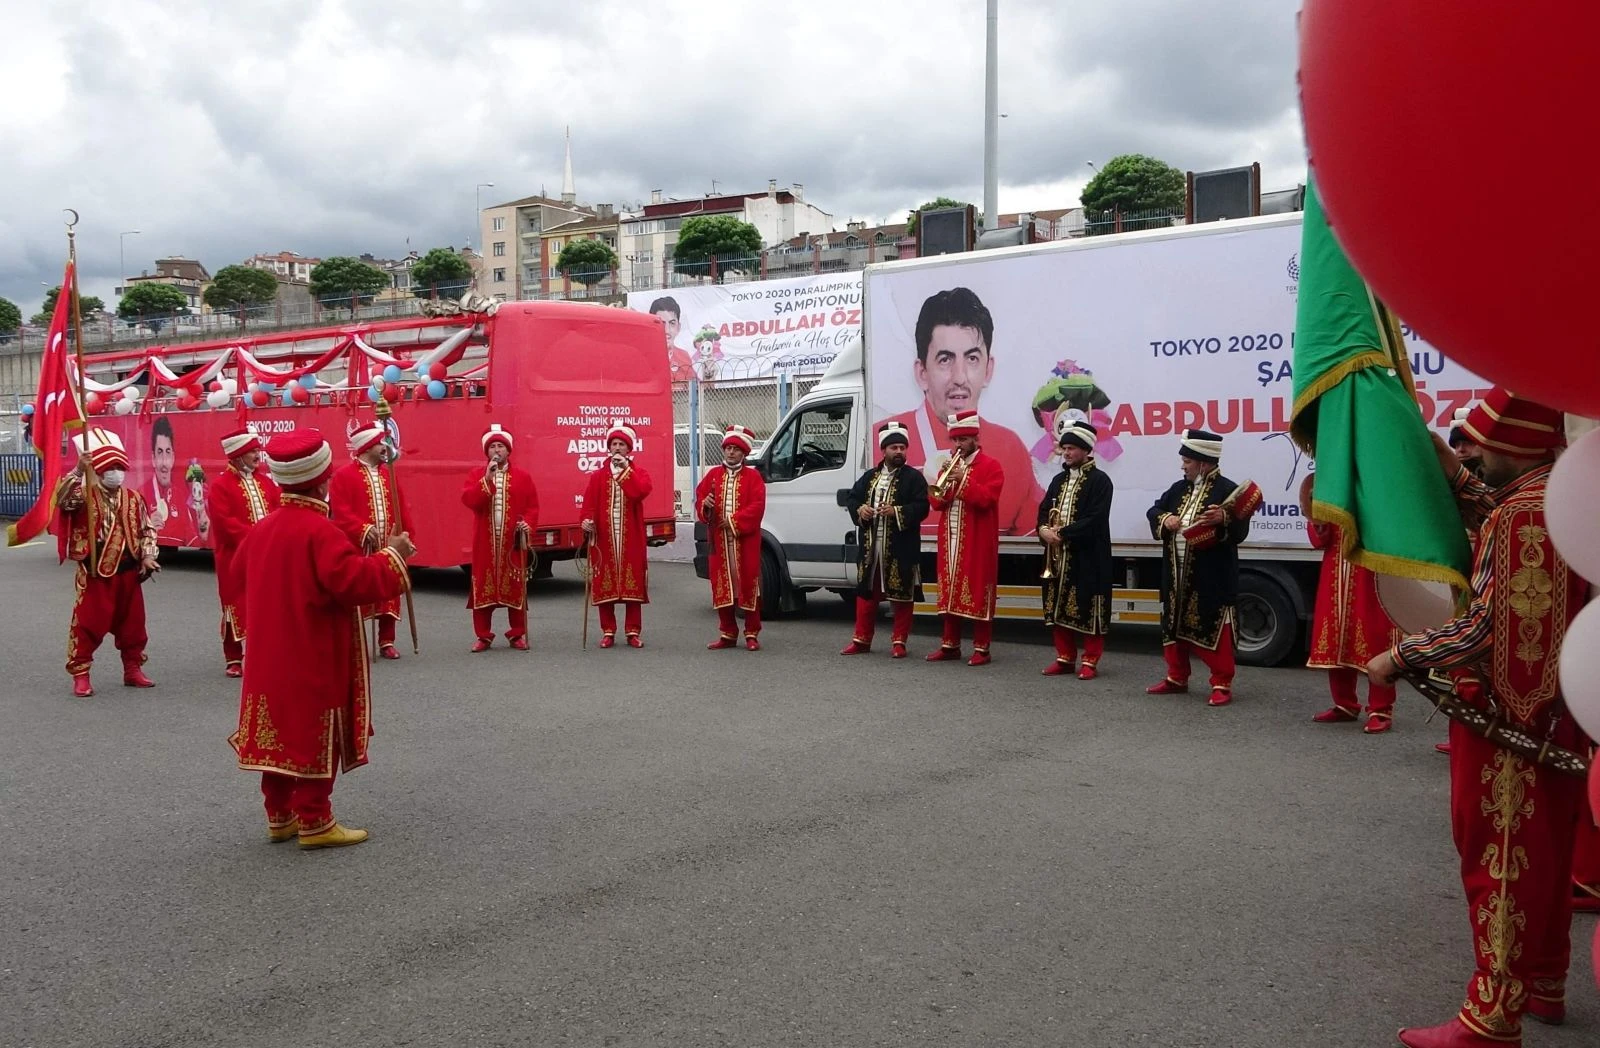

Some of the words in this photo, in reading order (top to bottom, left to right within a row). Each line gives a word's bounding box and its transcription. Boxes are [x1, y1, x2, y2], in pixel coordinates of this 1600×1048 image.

[732, 290, 763, 303] TOKYO
[765, 288, 792, 299] 2020
[718, 312, 826, 338] ABDULLAH
[831, 306, 862, 326] ÖZ
[1150, 337, 1221, 357] TOKYO
[1228, 333, 1283, 352] 2020
[798, 354, 838, 366] ZORLUO
[579, 405, 608, 415] TOKYO
[610, 406, 631, 415] 2020
[557, 415, 608, 426] PARALİMPİK
[1110, 397, 1291, 437] ABDULL
[273, 420, 295, 432] 2020
[581, 426, 608, 437] ŞAMPİ
[567, 439, 643, 454] ABDUH
[1256, 501, 1305, 517] Mura
[1251, 520, 1292, 530] Trabzon
